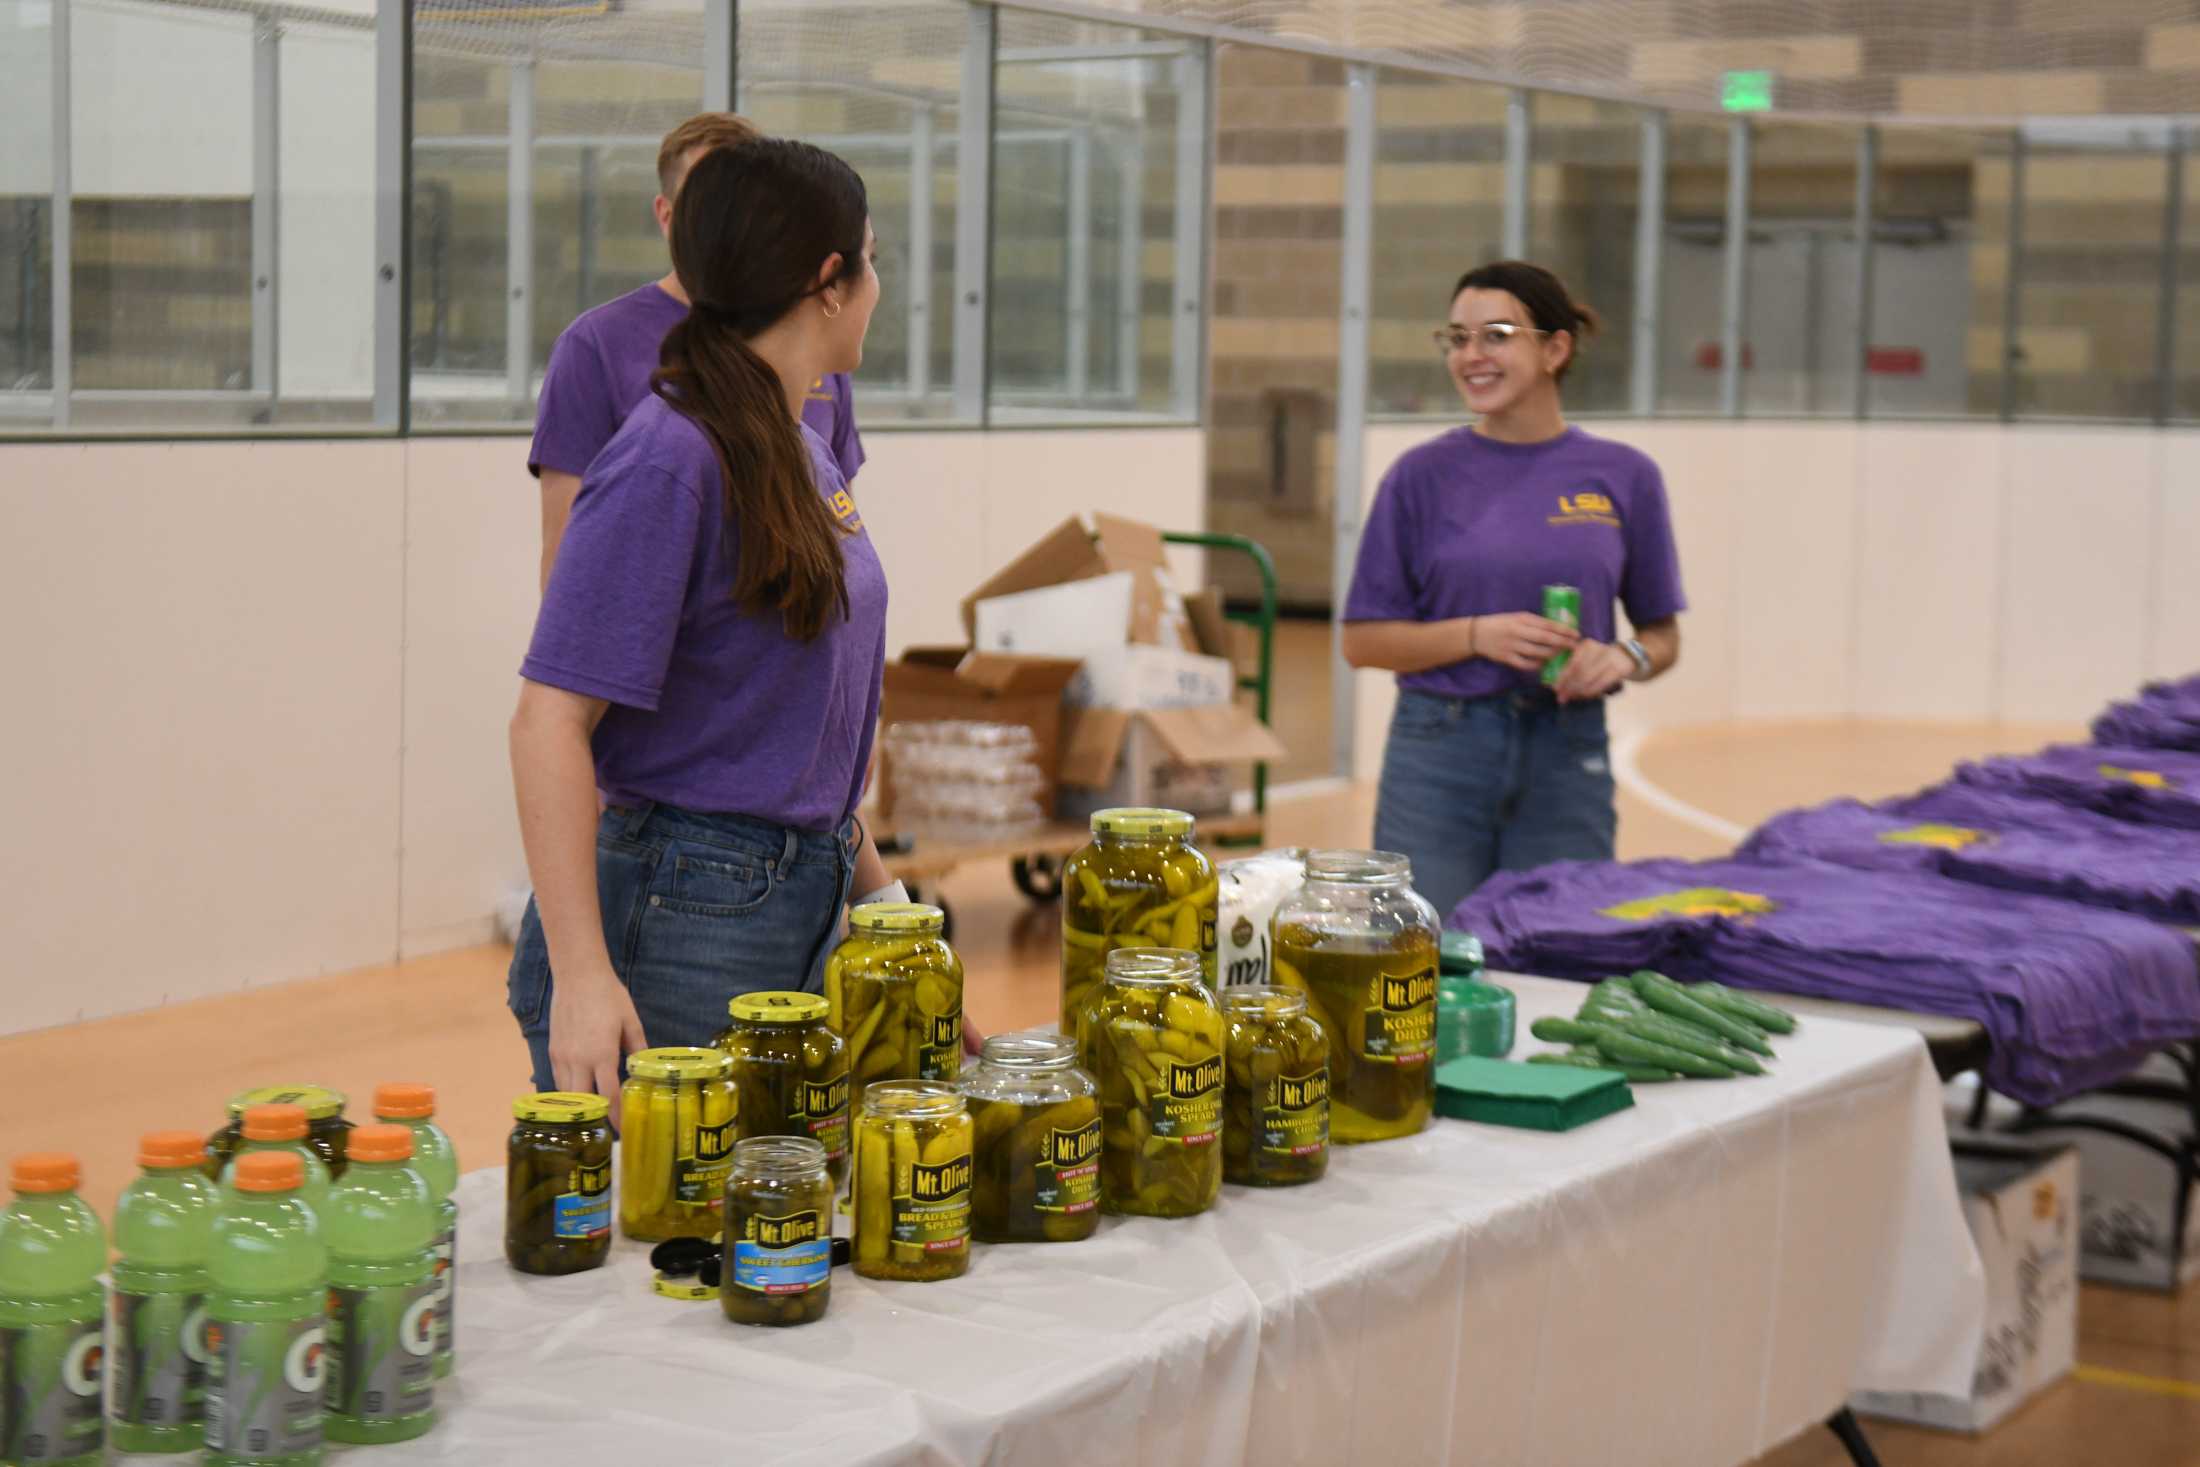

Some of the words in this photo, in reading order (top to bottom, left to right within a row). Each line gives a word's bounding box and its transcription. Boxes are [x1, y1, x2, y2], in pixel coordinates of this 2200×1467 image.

[1387, 981, 1408, 1006] Mt.
[1408, 976, 1434, 1005] Olive
[1384, 1012, 1434, 1031] KOSHER
[1395, 1028, 1428, 1043] DILLS
[1175, 1069, 1195, 1093] Mt.
[1195, 1064, 1220, 1090] Olive
[809, 1088, 828, 1112] Mt.
[1284, 1083, 1303, 1105] Mt.
[1303, 1077, 1328, 1104] Olive
[1180, 1110, 1216, 1122] SPEARS
[700, 1131, 720, 1154] Mt.
[1058, 1136, 1077, 1161] Mt.
[1078, 1129, 1100, 1158] Olive
[916, 1169, 940, 1195] Mt.
[940, 1164, 969, 1193] Olive
[899, 1212, 939, 1223] BREAD
[760, 1222, 779, 1243] Mt.
[781, 1220, 815, 1242] Olive
[285, 1328, 327, 1393] G
